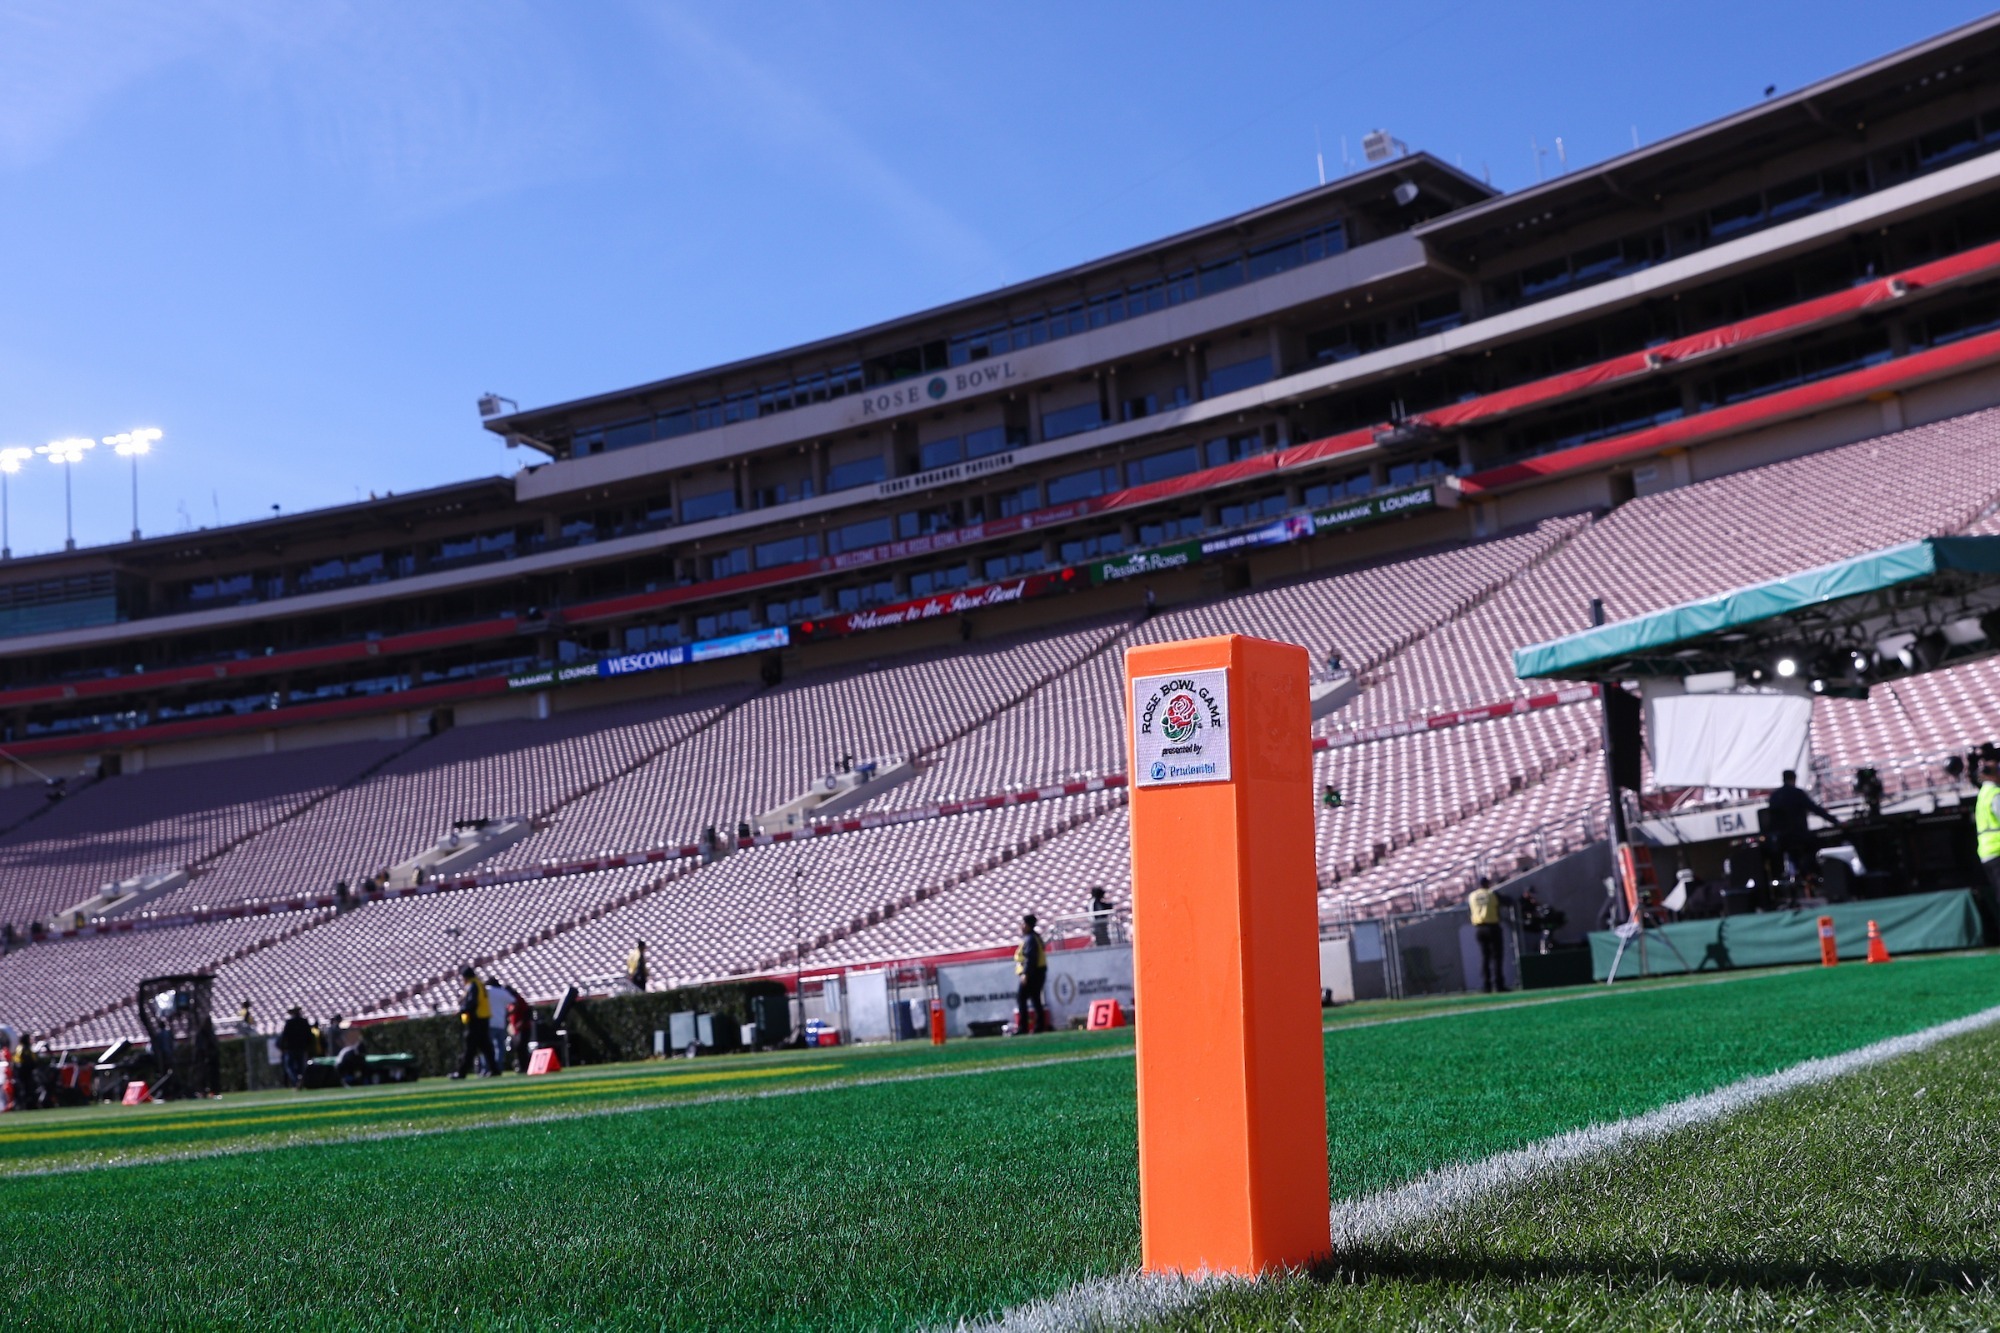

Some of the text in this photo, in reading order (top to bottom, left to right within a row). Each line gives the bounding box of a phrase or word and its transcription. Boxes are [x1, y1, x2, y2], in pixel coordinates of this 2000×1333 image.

[863, 362, 1016, 415] ROSE BOWL
[1380, 489, 1432, 513] LOUNGE
[834, 550, 875, 568] WELCOME
[878, 546, 890, 559] TO
[891, 542, 906, 556] THE
[909, 537, 931, 552] ROSE
[933, 532, 958, 548] BOWL
[960, 525, 984, 542] GAME
[1103, 553, 1189, 580] Passion Roses
[847, 579, 1026, 630] Welcome to the Rose Bowl
[559, 663, 598, 681] LOUNGE
[608, 650, 669, 674] WESCOM
[1142, 680, 1221, 734] ROSE BOWL GAME
[1162, 743, 1202, 757] presented by
[1170, 763, 1216, 777] Prudential
[1703, 787, 1748, 804] EXIT
[1716, 814, 1746, 833] 15A
[964, 993, 987, 1003] BOWL
[1094, 1004, 1110, 1026] G
